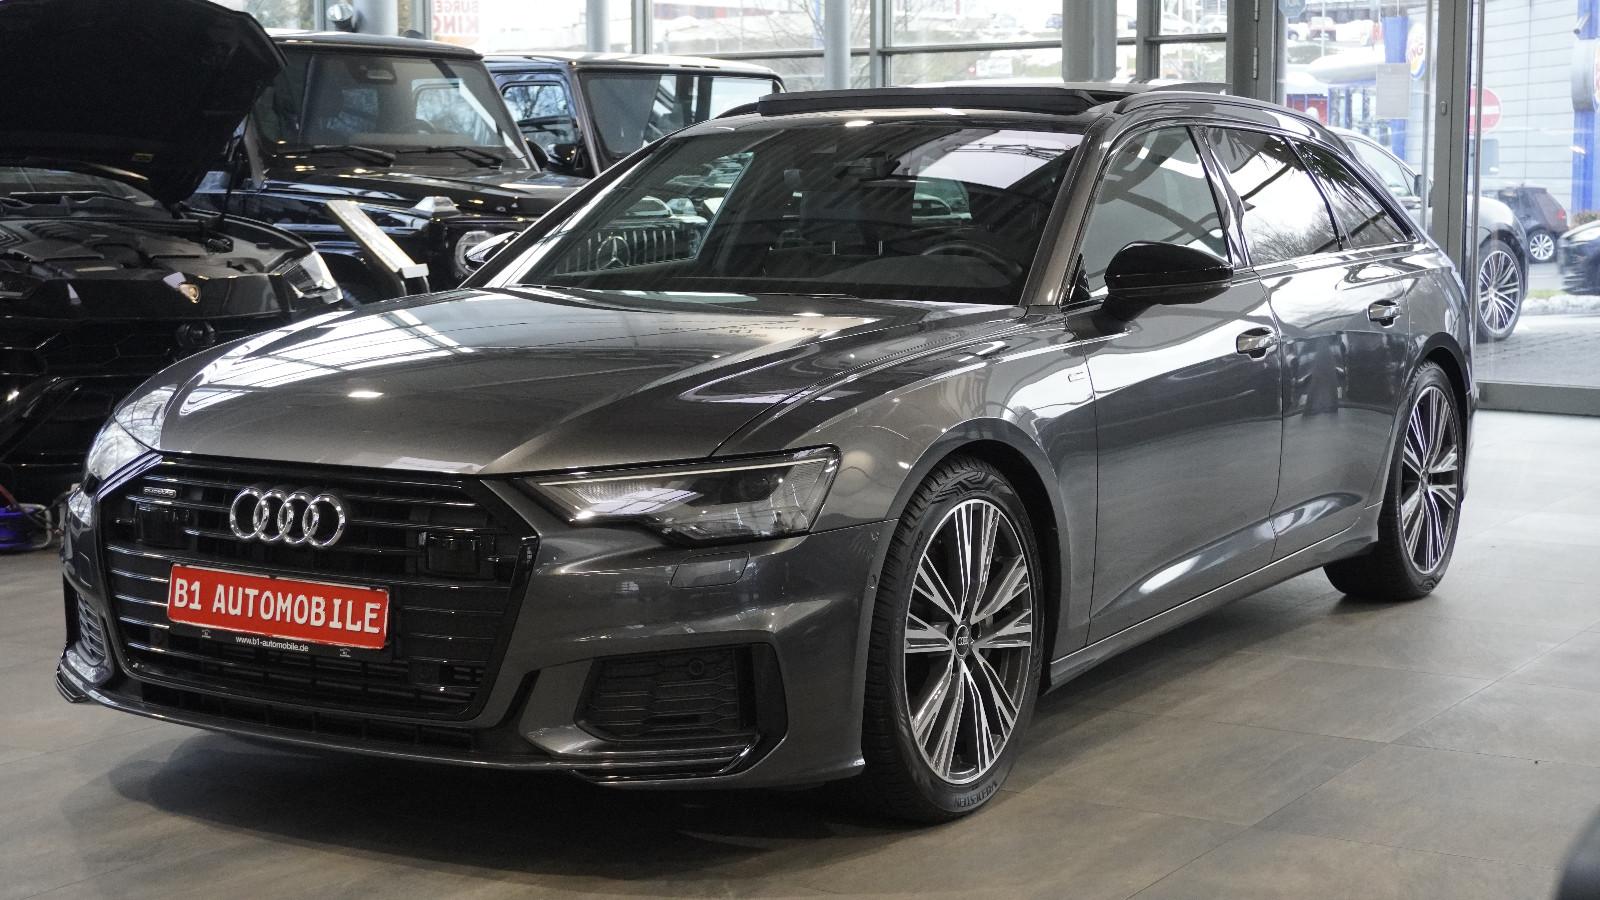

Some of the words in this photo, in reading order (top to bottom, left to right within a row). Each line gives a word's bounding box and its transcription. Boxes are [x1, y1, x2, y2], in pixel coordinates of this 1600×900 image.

[174, 578, 202, 610] B1
[212, 584, 381, 634] AUTOMOBILE
[235, 635, 309, 652] www.b1-automobile.de
